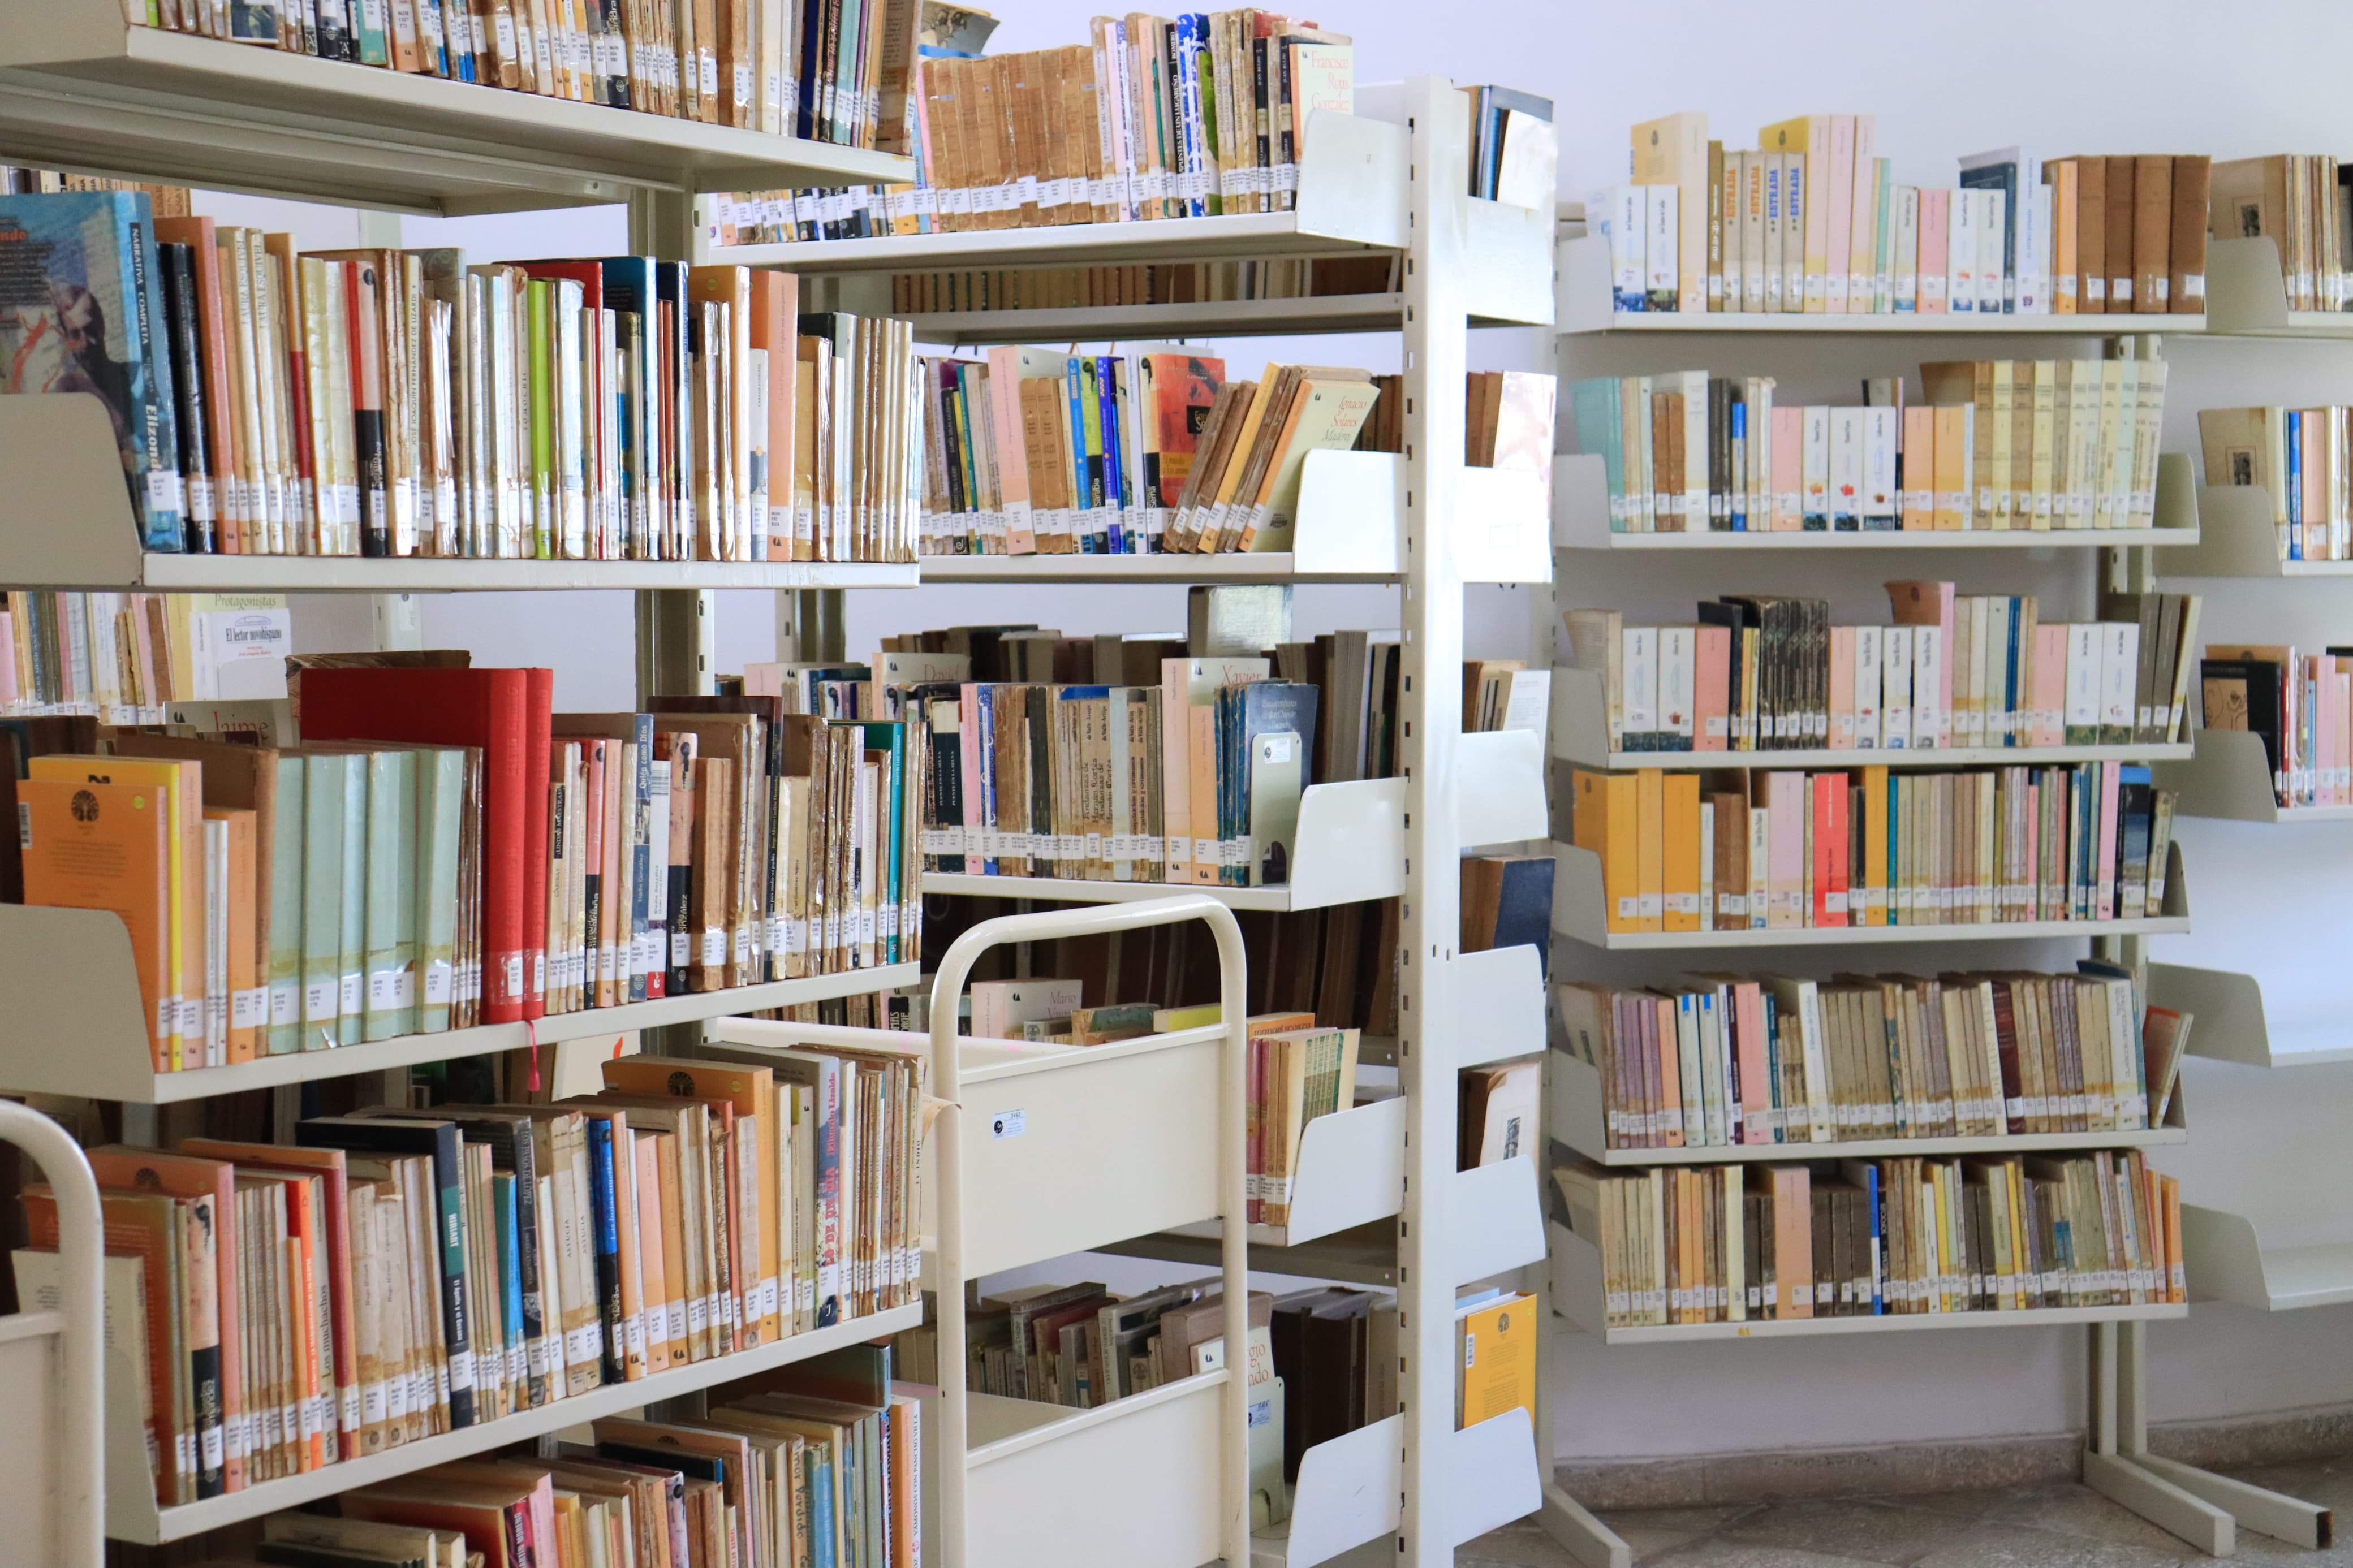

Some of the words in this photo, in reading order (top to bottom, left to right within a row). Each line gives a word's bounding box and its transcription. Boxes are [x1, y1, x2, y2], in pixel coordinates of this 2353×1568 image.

[1311, 50, 1349, 68] Francisco
[1171, 74, 1180, 116] LUGAREÑO
[1328, 72, 1349, 95] Rojas
[1312, 92, 1349, 111] González
[1175, 115, 1182, 128] UN
[1176, 127, 1183, 140] DE
[1726, 169, 1736, 218] ESTRADA
[1751, 165, 1760, 214] ESTRADA
[1769, 169, 1778, 218] ESTRADA
[1790, 167, 1799, 216] ESTRADA
[236, 240, 248, 287] ESQUIVEL
[254, 242, 265, 291] ESQUIVEL
[132, 228, 144, 284] NARRATIVA
[138, 292, 149, 344] COMPLETA
[240, 290, 249, 325] LAURA
[258, 295, 268, 329] LAURA
[410, 325, 417, 336] DE
[409, 338, 417, 386] FERNÁNDEZ
[409, 387, 417, 425] JOAQUÍN
[1338, 396, 1368, 416] Ignacio
[1333, 413, 1358, 427] Solares
[409, 427, 417, 446] JOSÉ
[214, 594, 277, 610] Protagonistas
[226, 628, 232, 642] El
[233, 627, 248, 641] lector
[249, 626, 282, 642] novohispano
[924, 663, 960, 681] David
[1221, 665, 1262, 685] Xavier
[212, 711, 269, 740] Jaime
[1082, 762, 1089, 772] de
[1098, 763, 1104, 773] de
[1082, 773, 1091, 820] Andanzas
[1049, 991, 1076, 1005] Mario
[1254, 1025, 1283, 1036] manuel
[1284, 1022, 1311, 1032] scorza
[828, 1072, 836, 1109] Lizalde
[521, 1130, 531, 1146] LOS
[826, 1110, 836, 1155] Eduardo
[521, 1147, 531, 1169] PASOS
[522, 1170, 531, 1181] DE
[605, 1156, 614, 1194] muertas
[824, 1167, 836, 1193] DÍA
[523, 1181, 533, 1204] LÓPEZ
[824, 1198, 835, 1220] UN
[448, 1213, 459, 1247] HIRIART
[824, 1223, 835, 1244] DE
[318, 1284, 330, 1352] muchachos
[321, 1355, 331, 1379] Los
[795, 1485, 806, 1539] Perdido
[514, 1512, 524, 1544] MORENO
